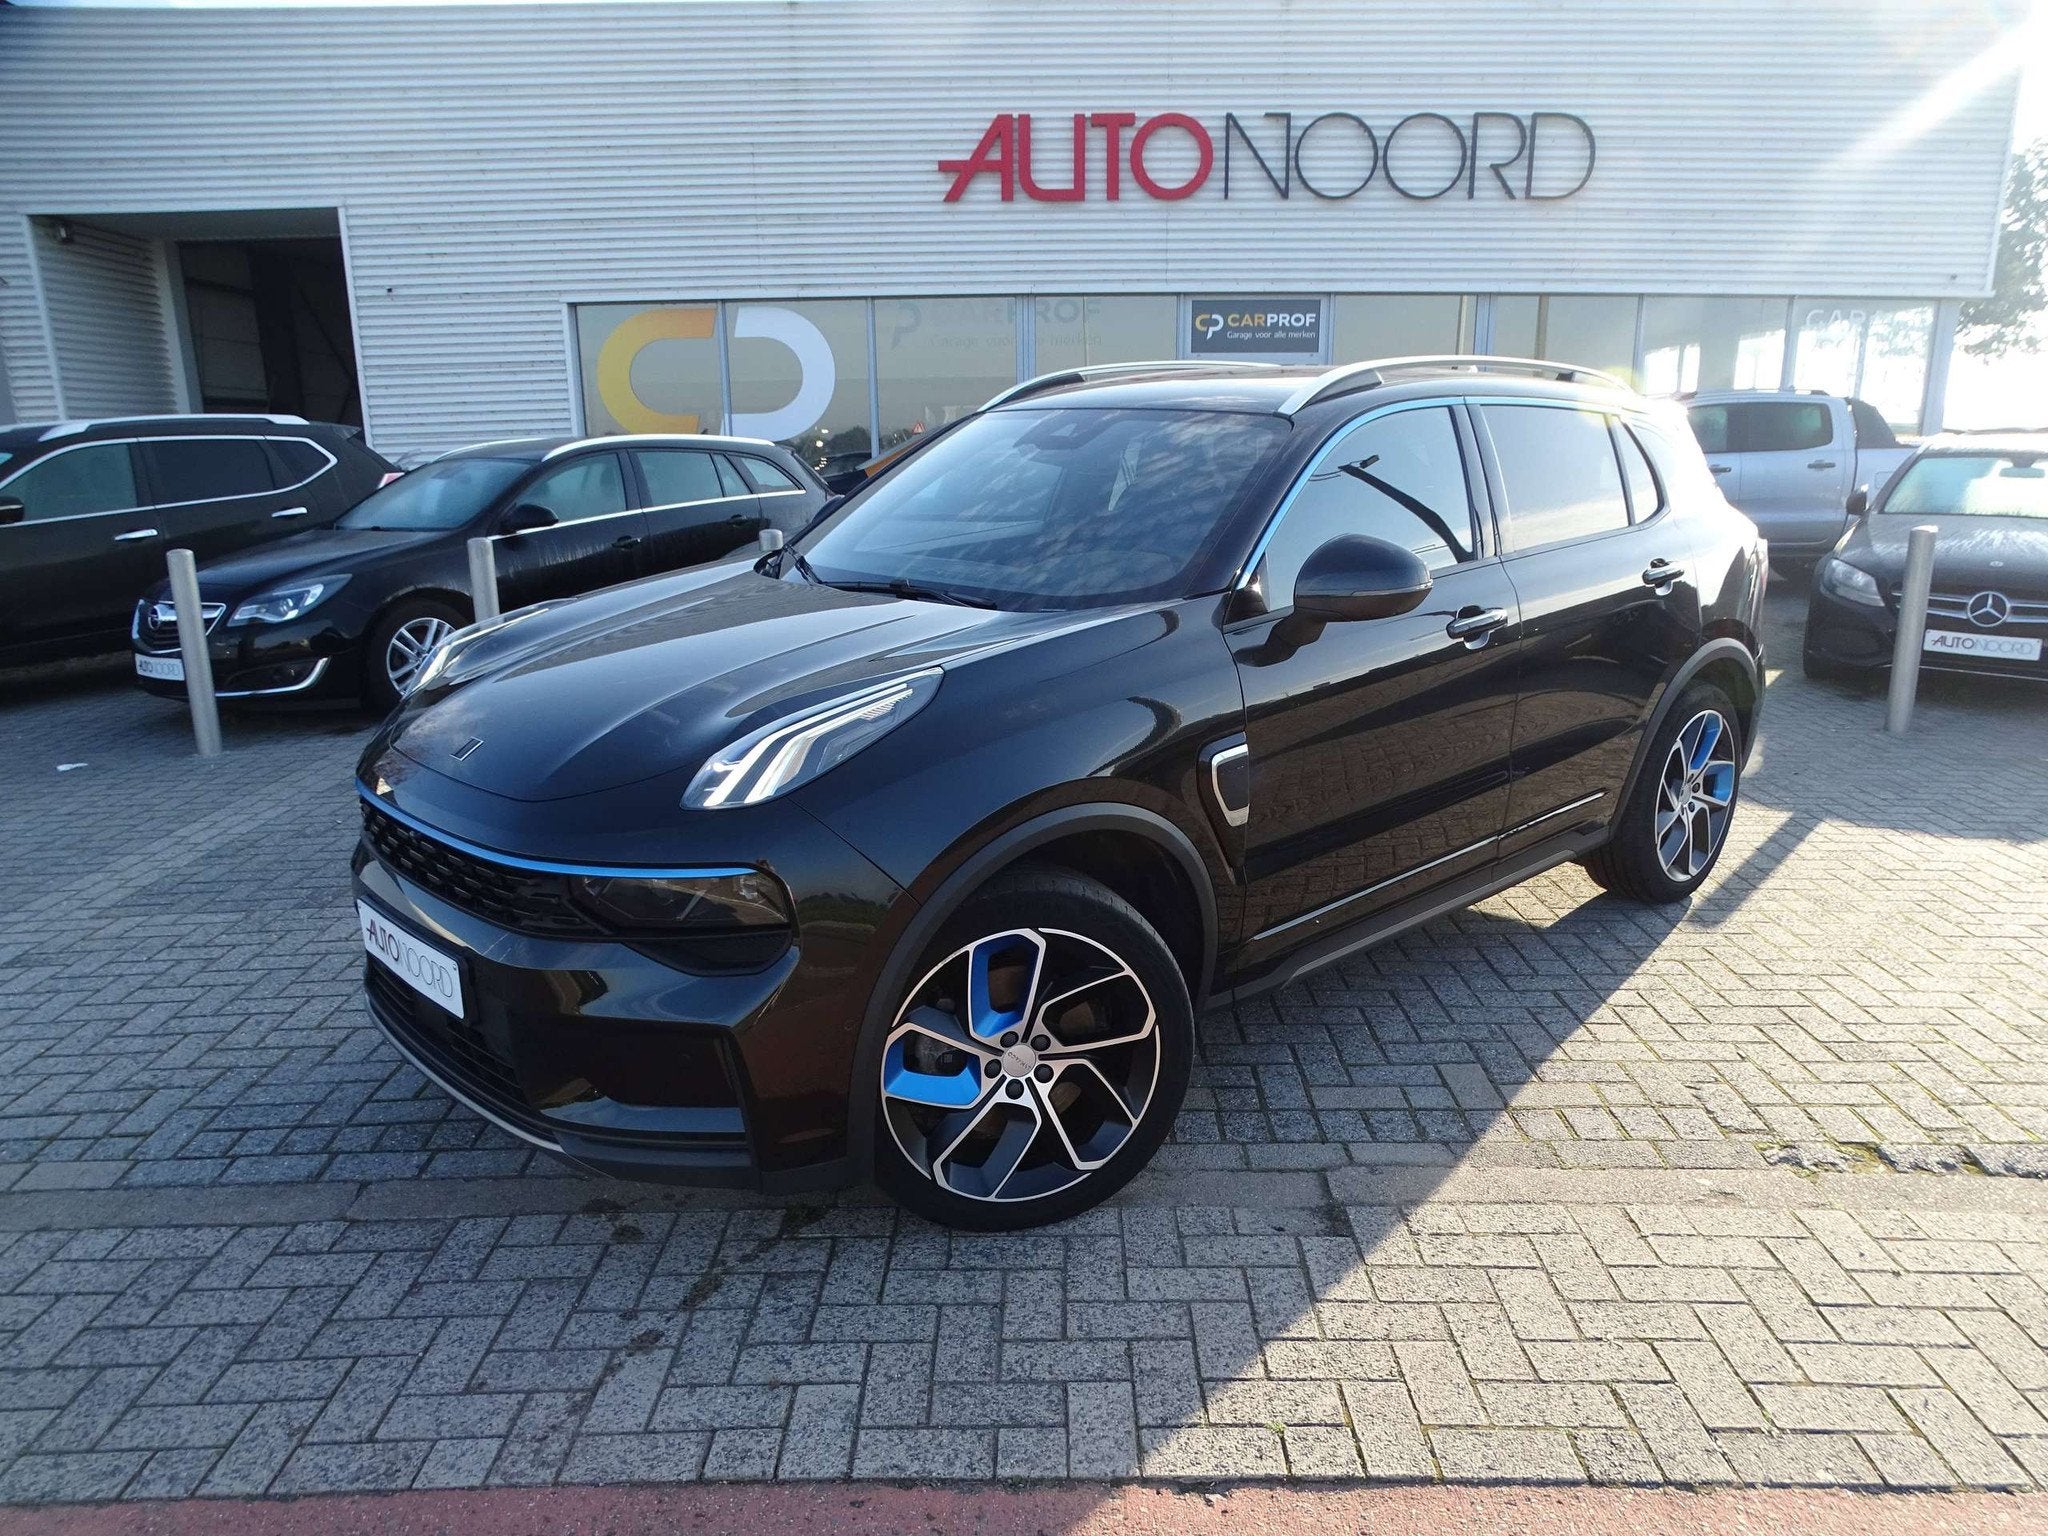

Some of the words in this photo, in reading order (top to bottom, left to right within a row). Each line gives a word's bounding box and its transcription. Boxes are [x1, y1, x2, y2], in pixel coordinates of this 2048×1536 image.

[1227, 313, 1316, 327] CARPROF
[1226, 331, 1253, 340] Garage
[1274, 330, 1287, 338] alle
[1288, 331, 1316, 339] merken
